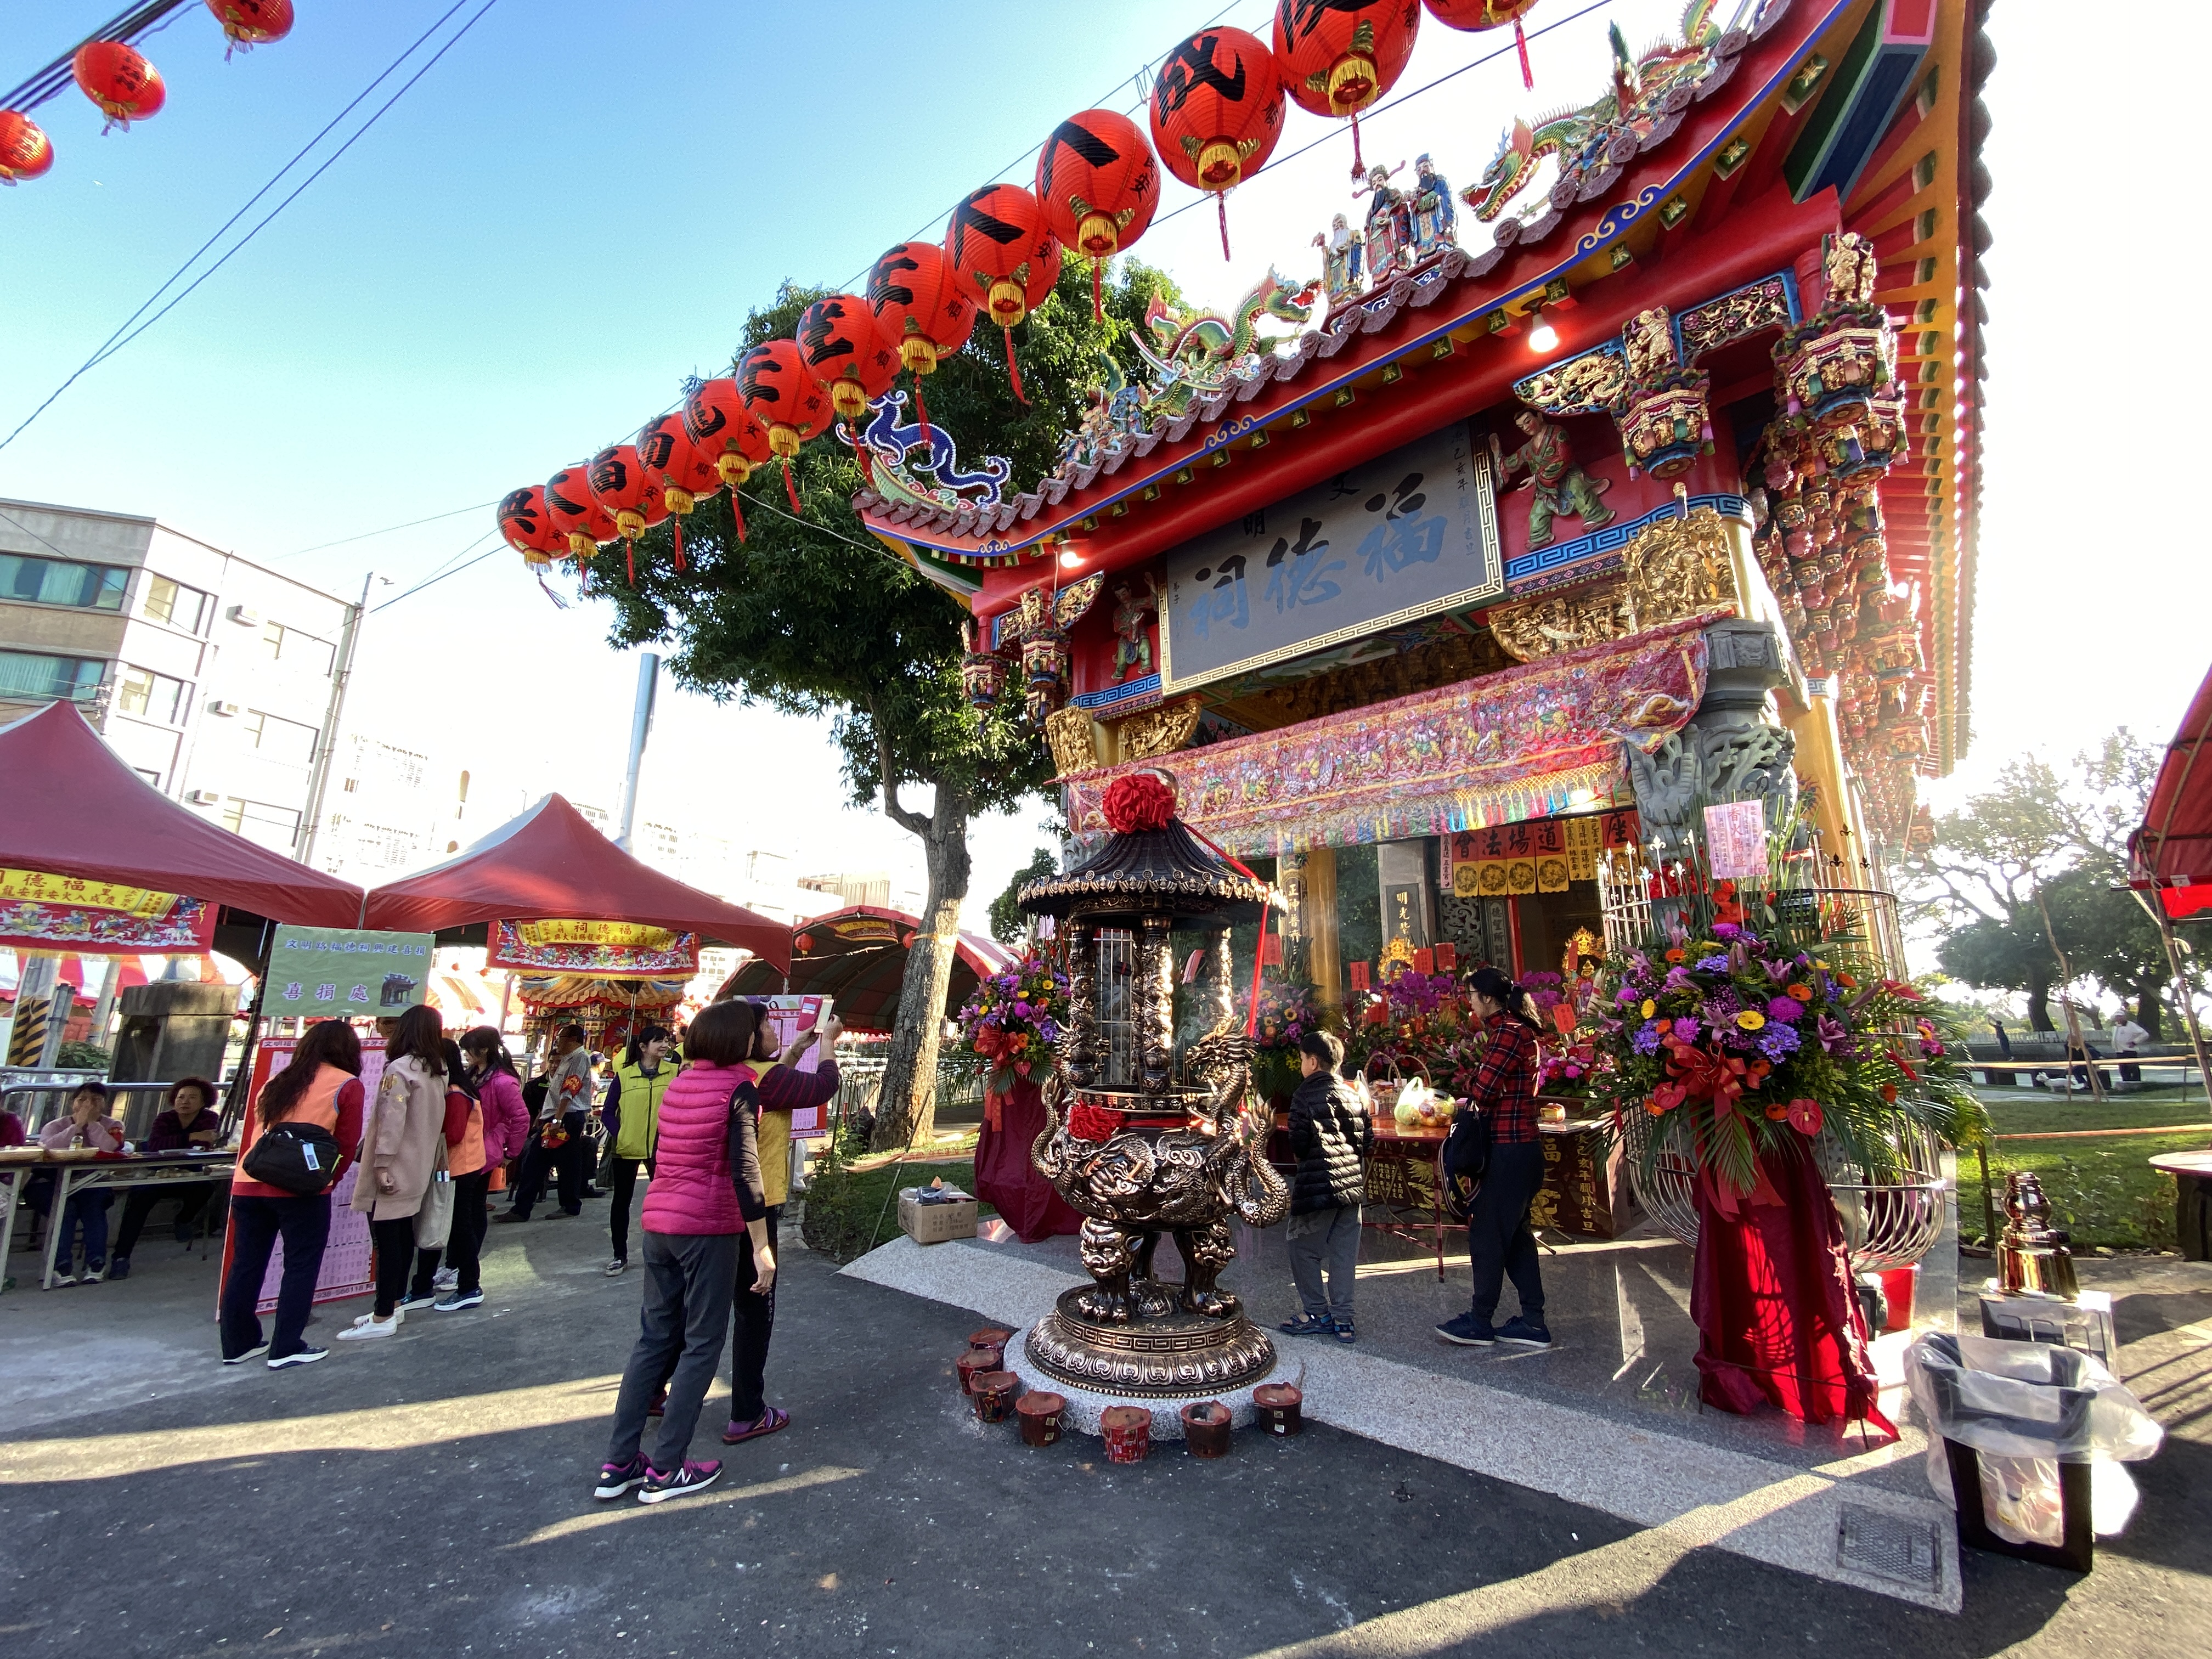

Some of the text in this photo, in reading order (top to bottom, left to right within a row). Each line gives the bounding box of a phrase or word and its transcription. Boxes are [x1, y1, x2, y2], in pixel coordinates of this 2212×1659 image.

[1728, 808, 1747, 868] 香火鼎盛
[286, 939, 426, 956] 文明路福德祠興建喜捐
[283, 981, 370, 1001] 喜捐處
